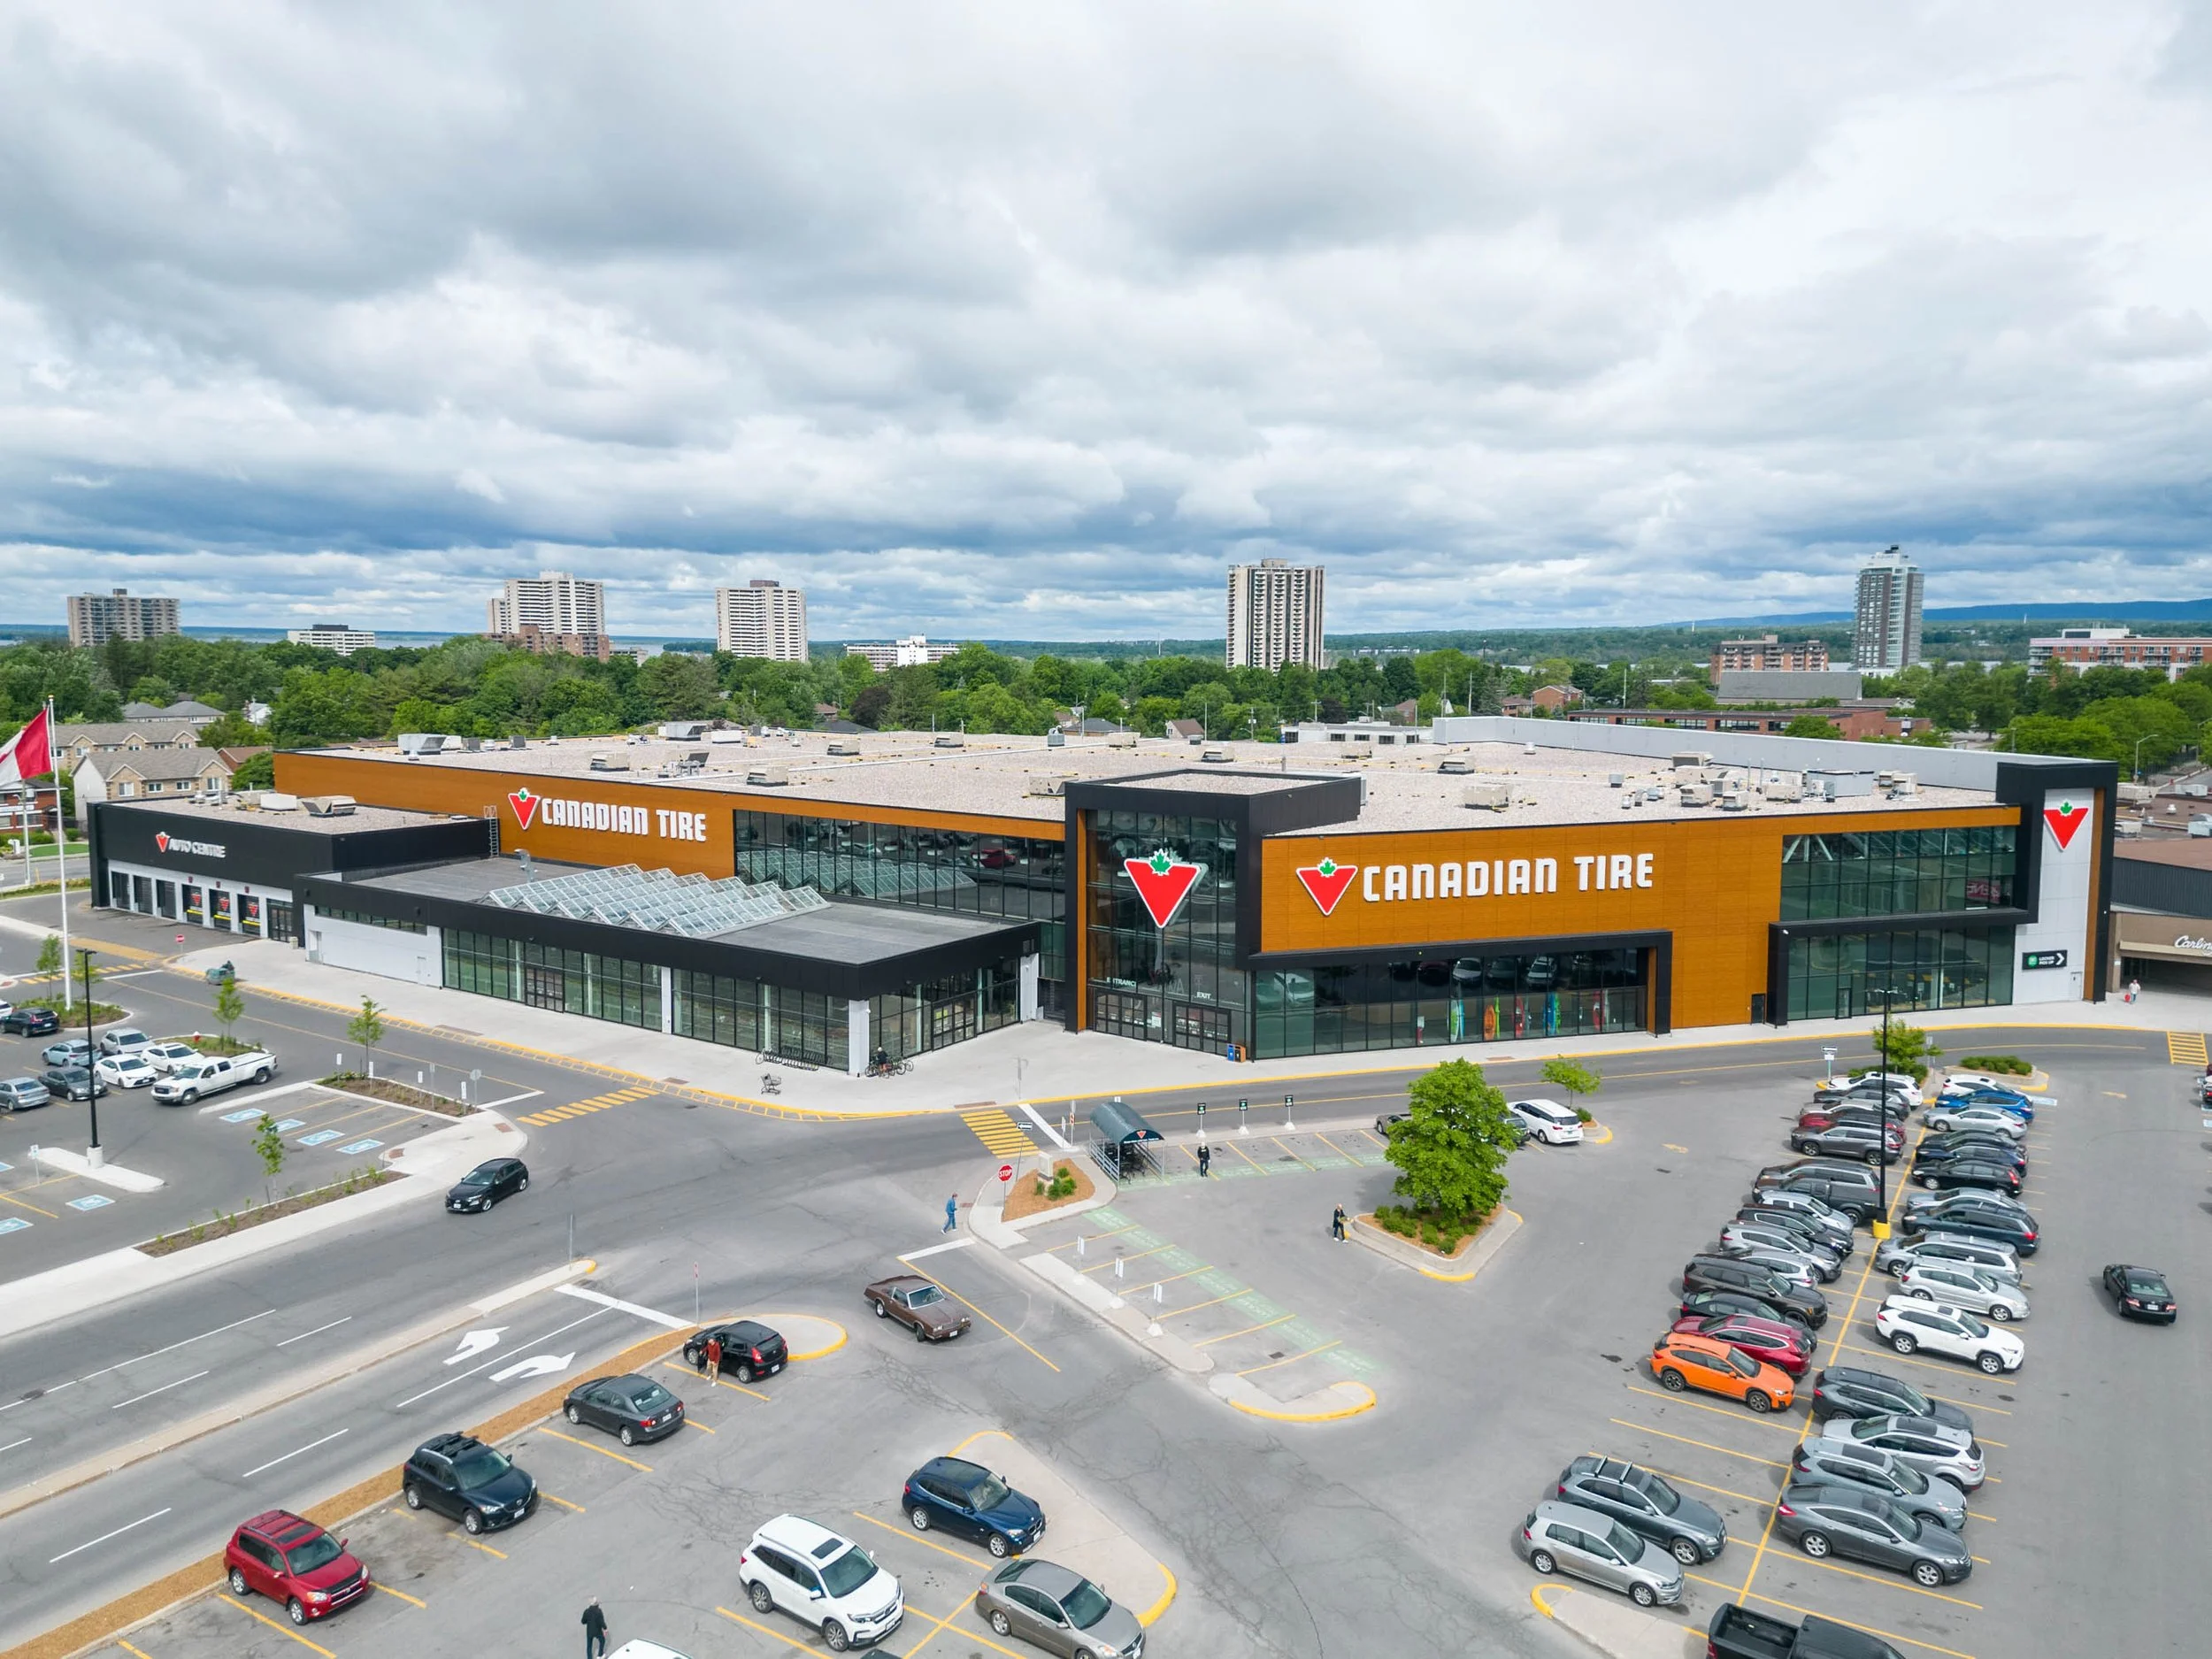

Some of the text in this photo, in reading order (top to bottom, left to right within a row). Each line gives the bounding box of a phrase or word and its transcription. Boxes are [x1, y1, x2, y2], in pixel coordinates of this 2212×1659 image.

[541, 798, 707, 841] CANADIAN TIRE
[168, 838, 226, 858] AUTO CENTRE
[1363, 853, 1654, 902] CANADIAN TIRE
[1196, 991, 1211, 1000] EXIT
